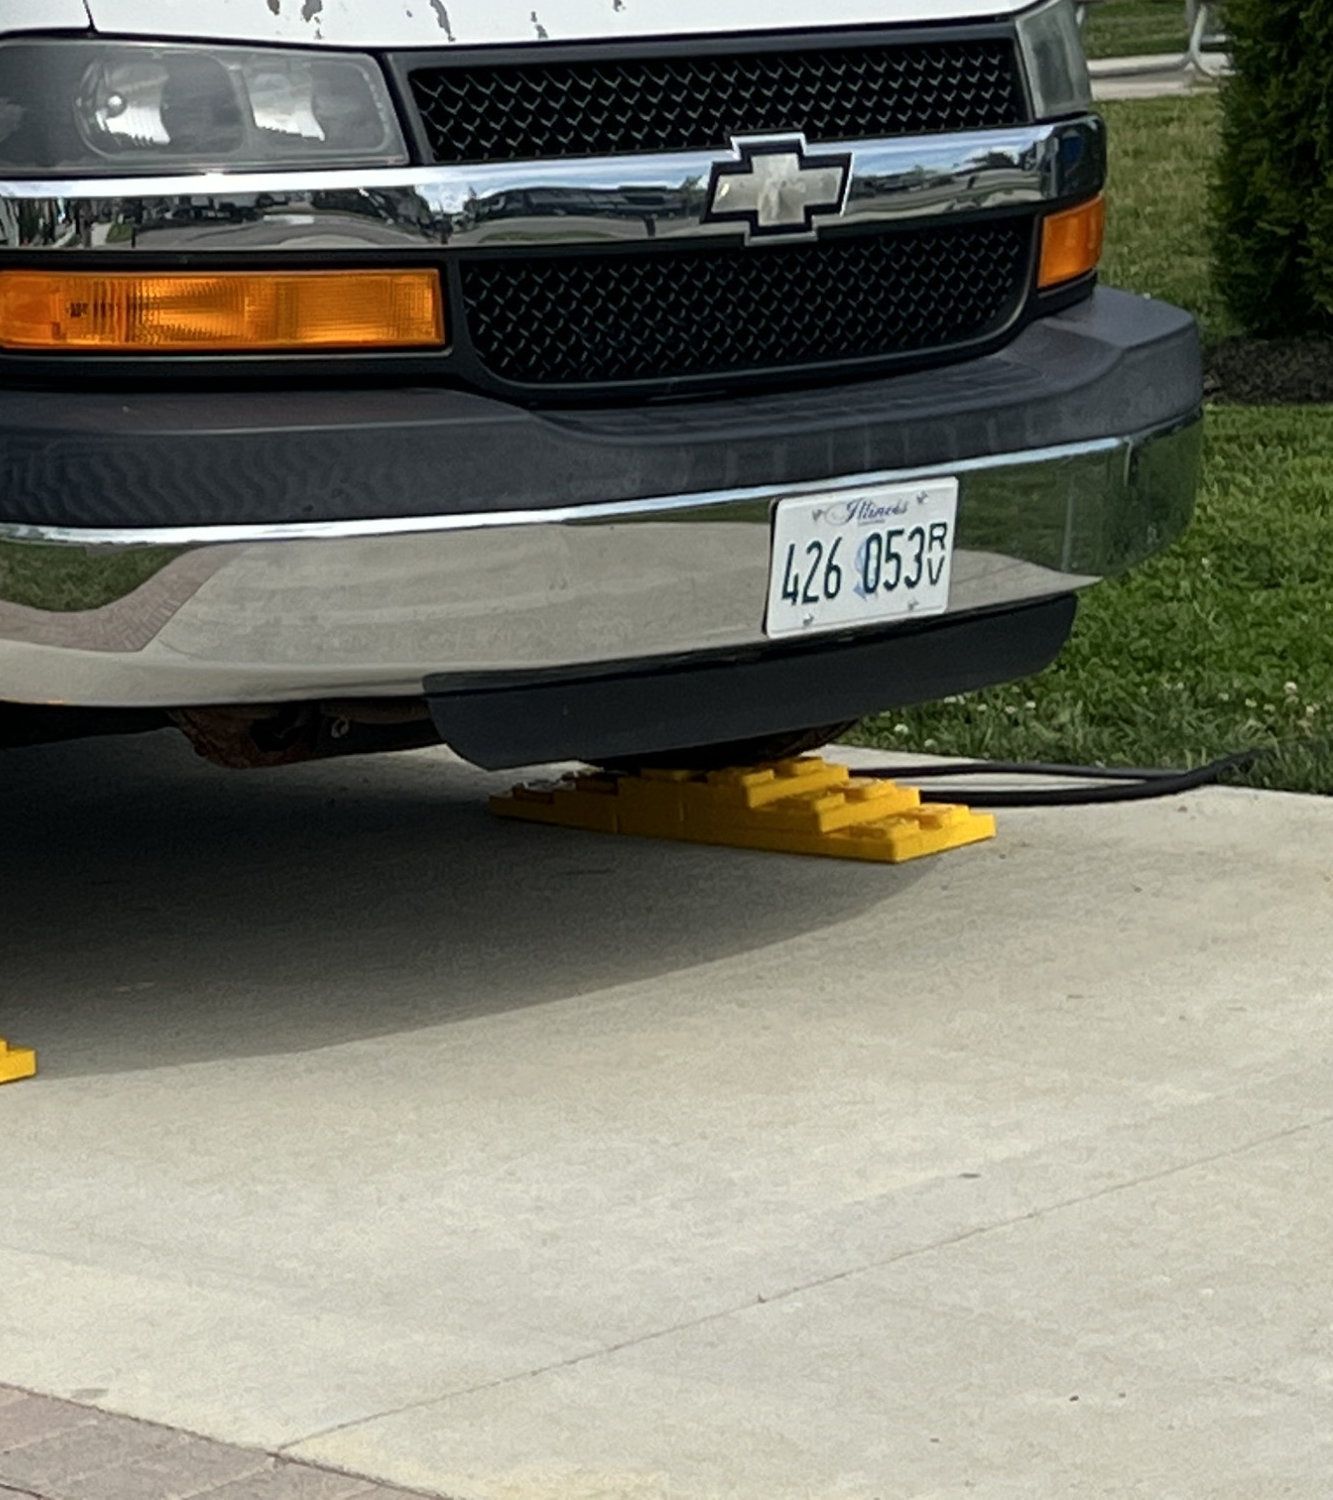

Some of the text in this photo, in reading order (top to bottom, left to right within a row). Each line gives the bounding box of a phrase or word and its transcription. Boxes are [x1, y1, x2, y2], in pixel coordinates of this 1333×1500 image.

[825, 497, 910, 526] Illinois
[781, 536, 843, 607] 426
[862, 526, 926, 594] 053
